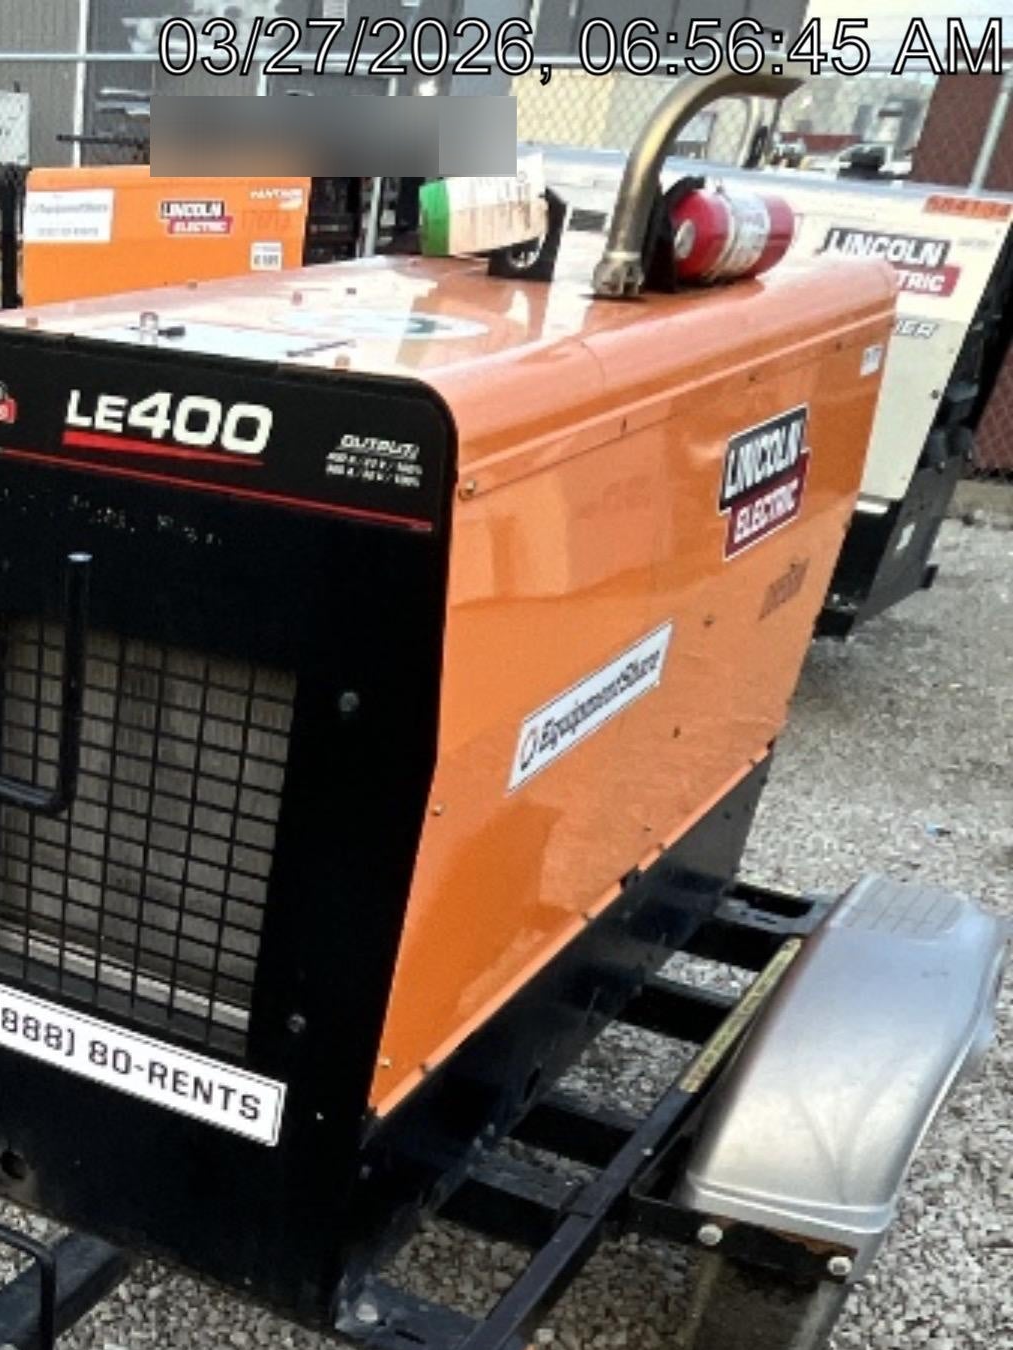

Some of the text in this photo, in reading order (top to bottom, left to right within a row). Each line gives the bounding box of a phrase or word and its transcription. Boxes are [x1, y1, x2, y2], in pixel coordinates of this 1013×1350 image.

[163, 202, 222, 217] LINCOLN
[826, 229, 944, 268] LINCOLN
[896, 269, 946, 292] TRIC
[64, 389, 274, 454] LE400
[724, 419, 803, 500] LINCOLN
[733, 477, 799, 544] ELECTRIC
[539, 650, 661, 753] EquipmentShare
[88, 1040, 262, 1121] 80-RENTS
